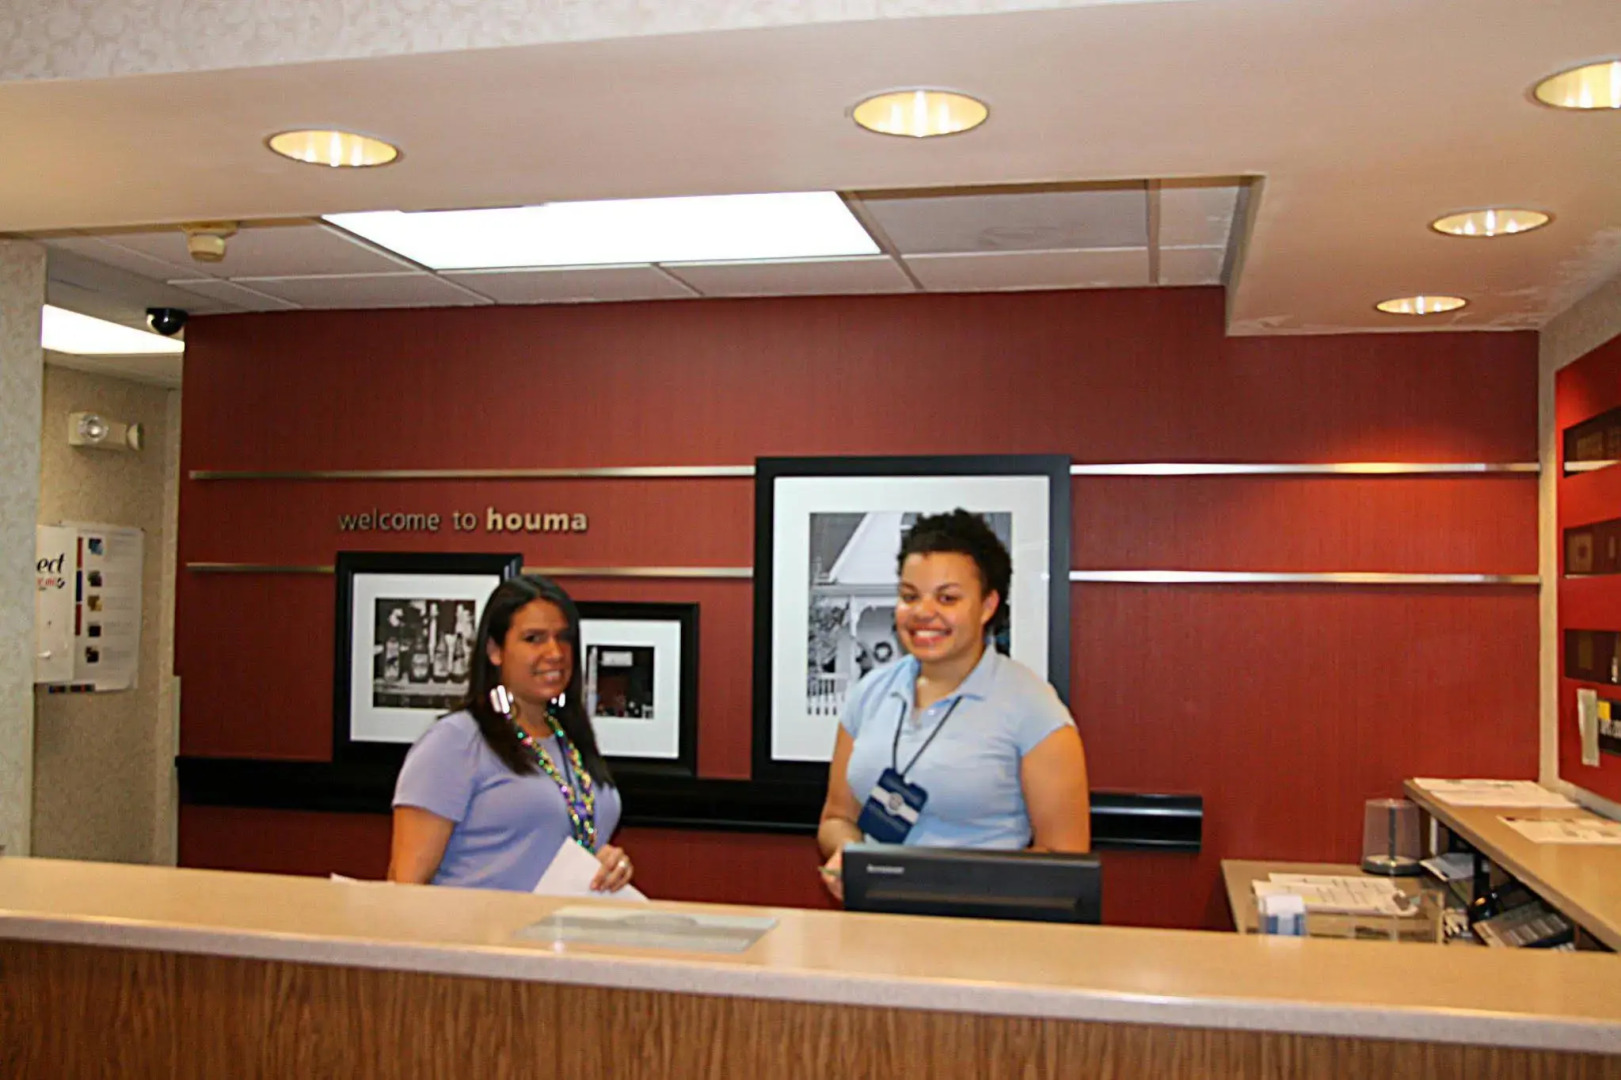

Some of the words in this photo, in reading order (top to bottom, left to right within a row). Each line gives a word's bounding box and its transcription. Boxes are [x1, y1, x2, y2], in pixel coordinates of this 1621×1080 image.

[338, 507, 440, 531] welcome
[453, 510, 477, 531] to
[486, 506, 588, 531] houma
